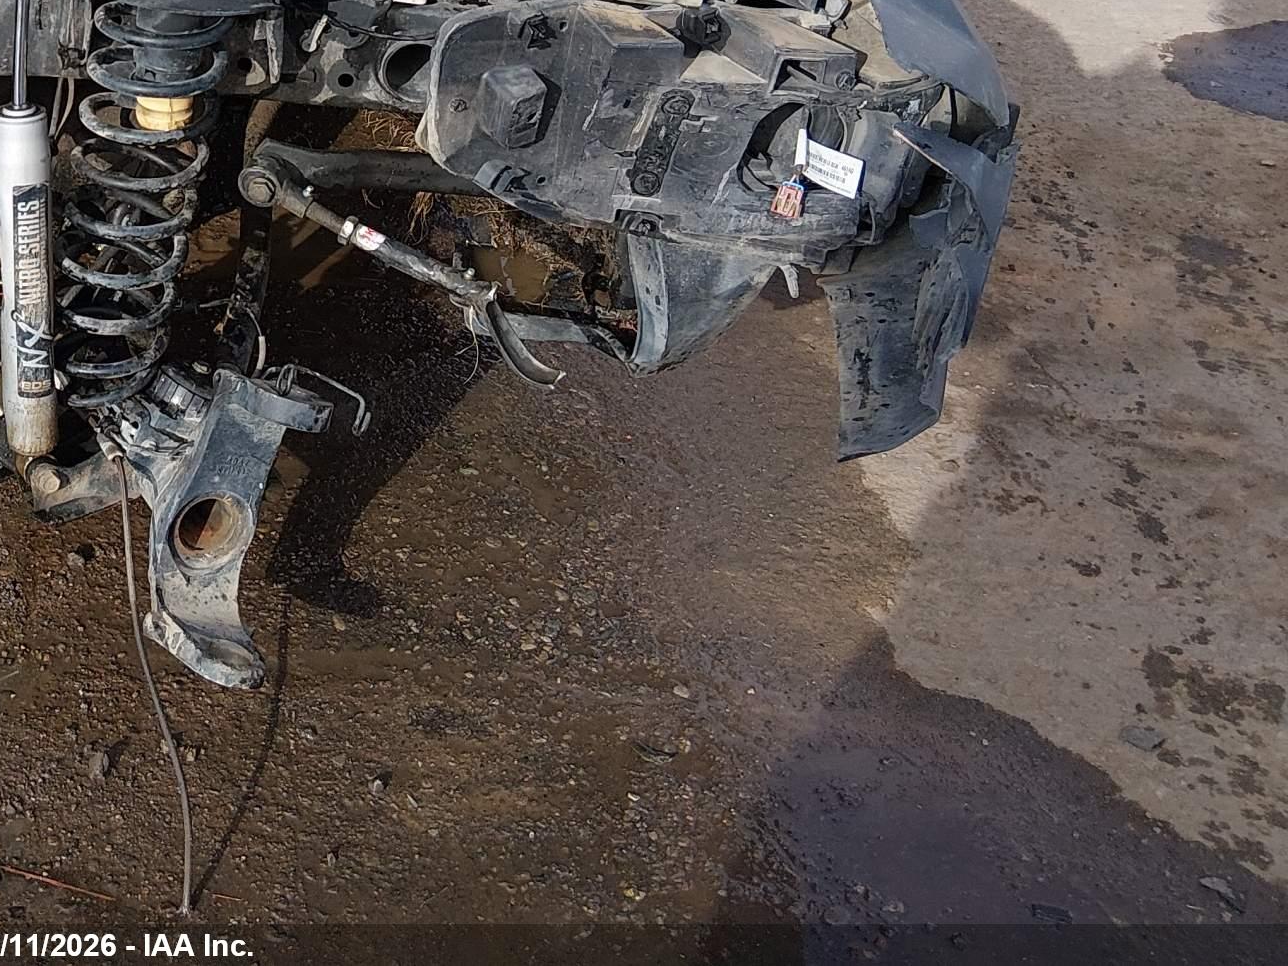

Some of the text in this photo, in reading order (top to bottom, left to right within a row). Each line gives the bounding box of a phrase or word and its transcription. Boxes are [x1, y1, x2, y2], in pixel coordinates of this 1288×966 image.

[17, 200, 41, 255] SERIES
[18, 259, 41, 305] NITRO
[21, 379, 52, 391] BDS
